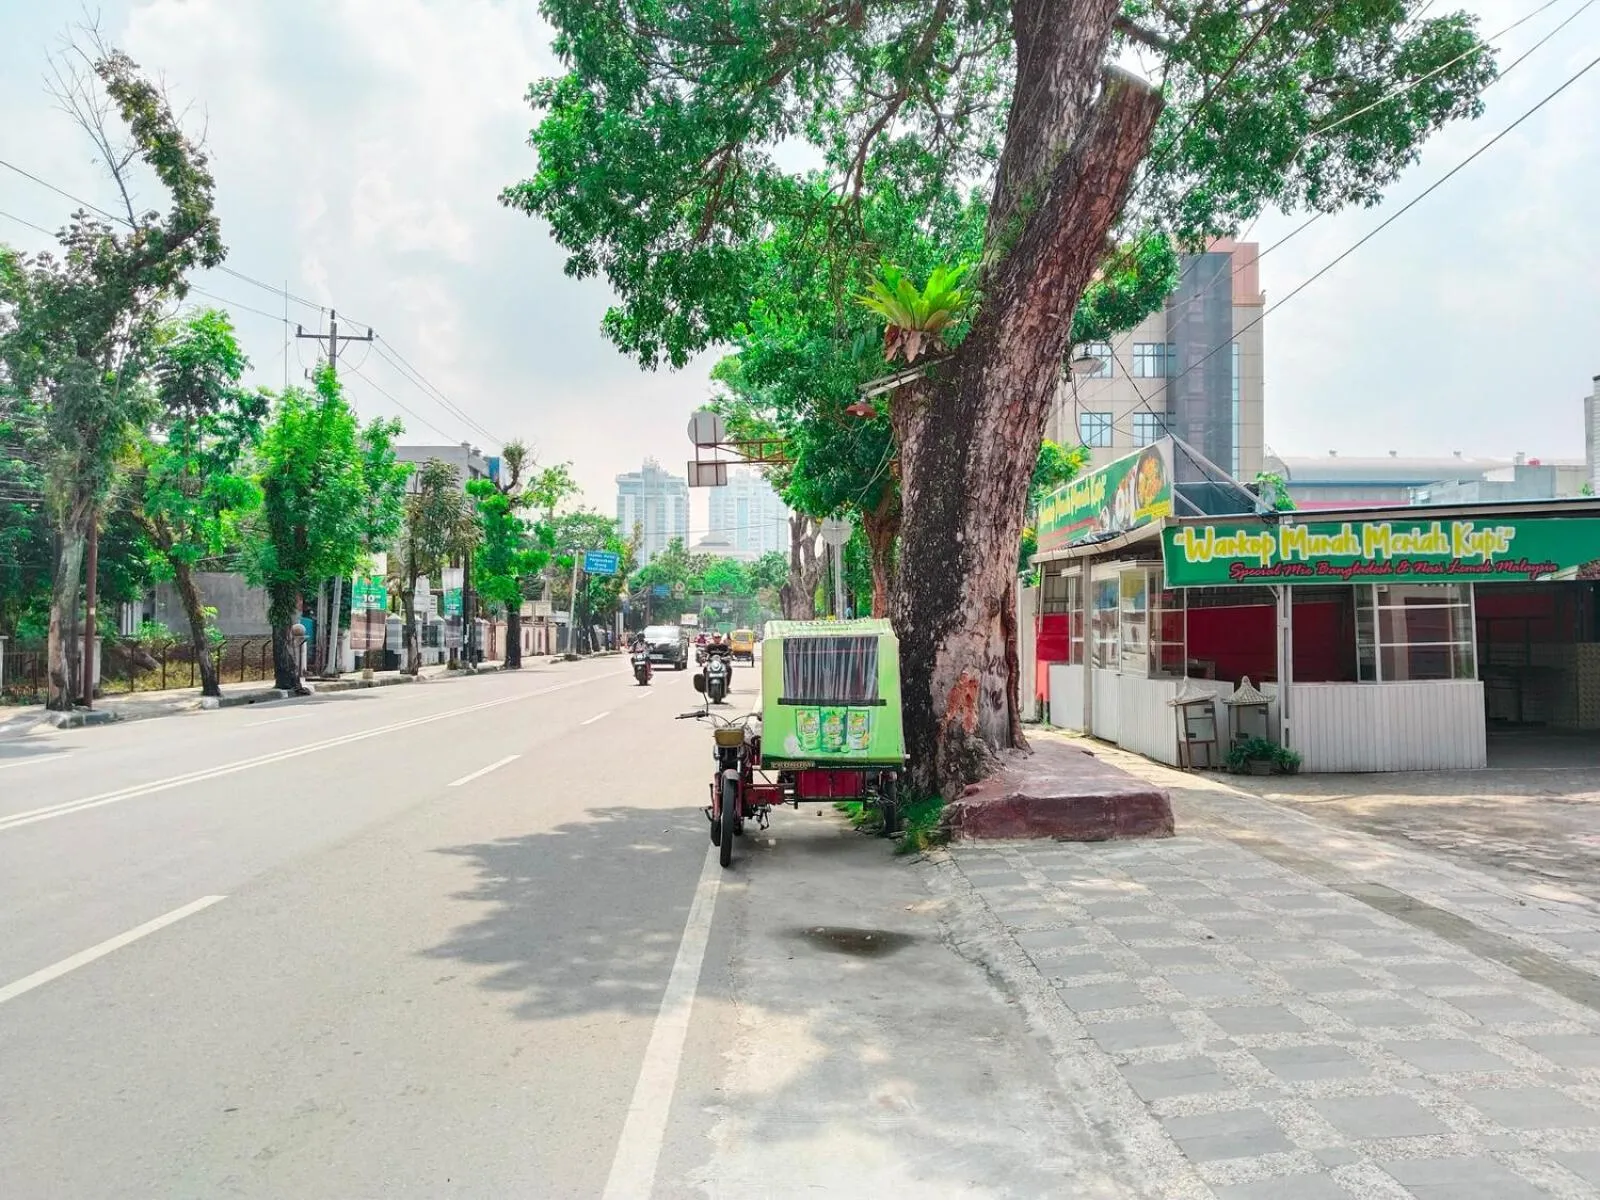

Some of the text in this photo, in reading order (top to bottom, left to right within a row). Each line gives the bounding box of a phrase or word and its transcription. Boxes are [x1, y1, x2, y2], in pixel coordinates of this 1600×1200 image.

[1280, 523, 1360, 560] Murah
[1362, 522, 1450, 558] Meriah
[1230, 558, 1559, 583] Special Mie Bangladesh & Nasi Lemak Malaysia
